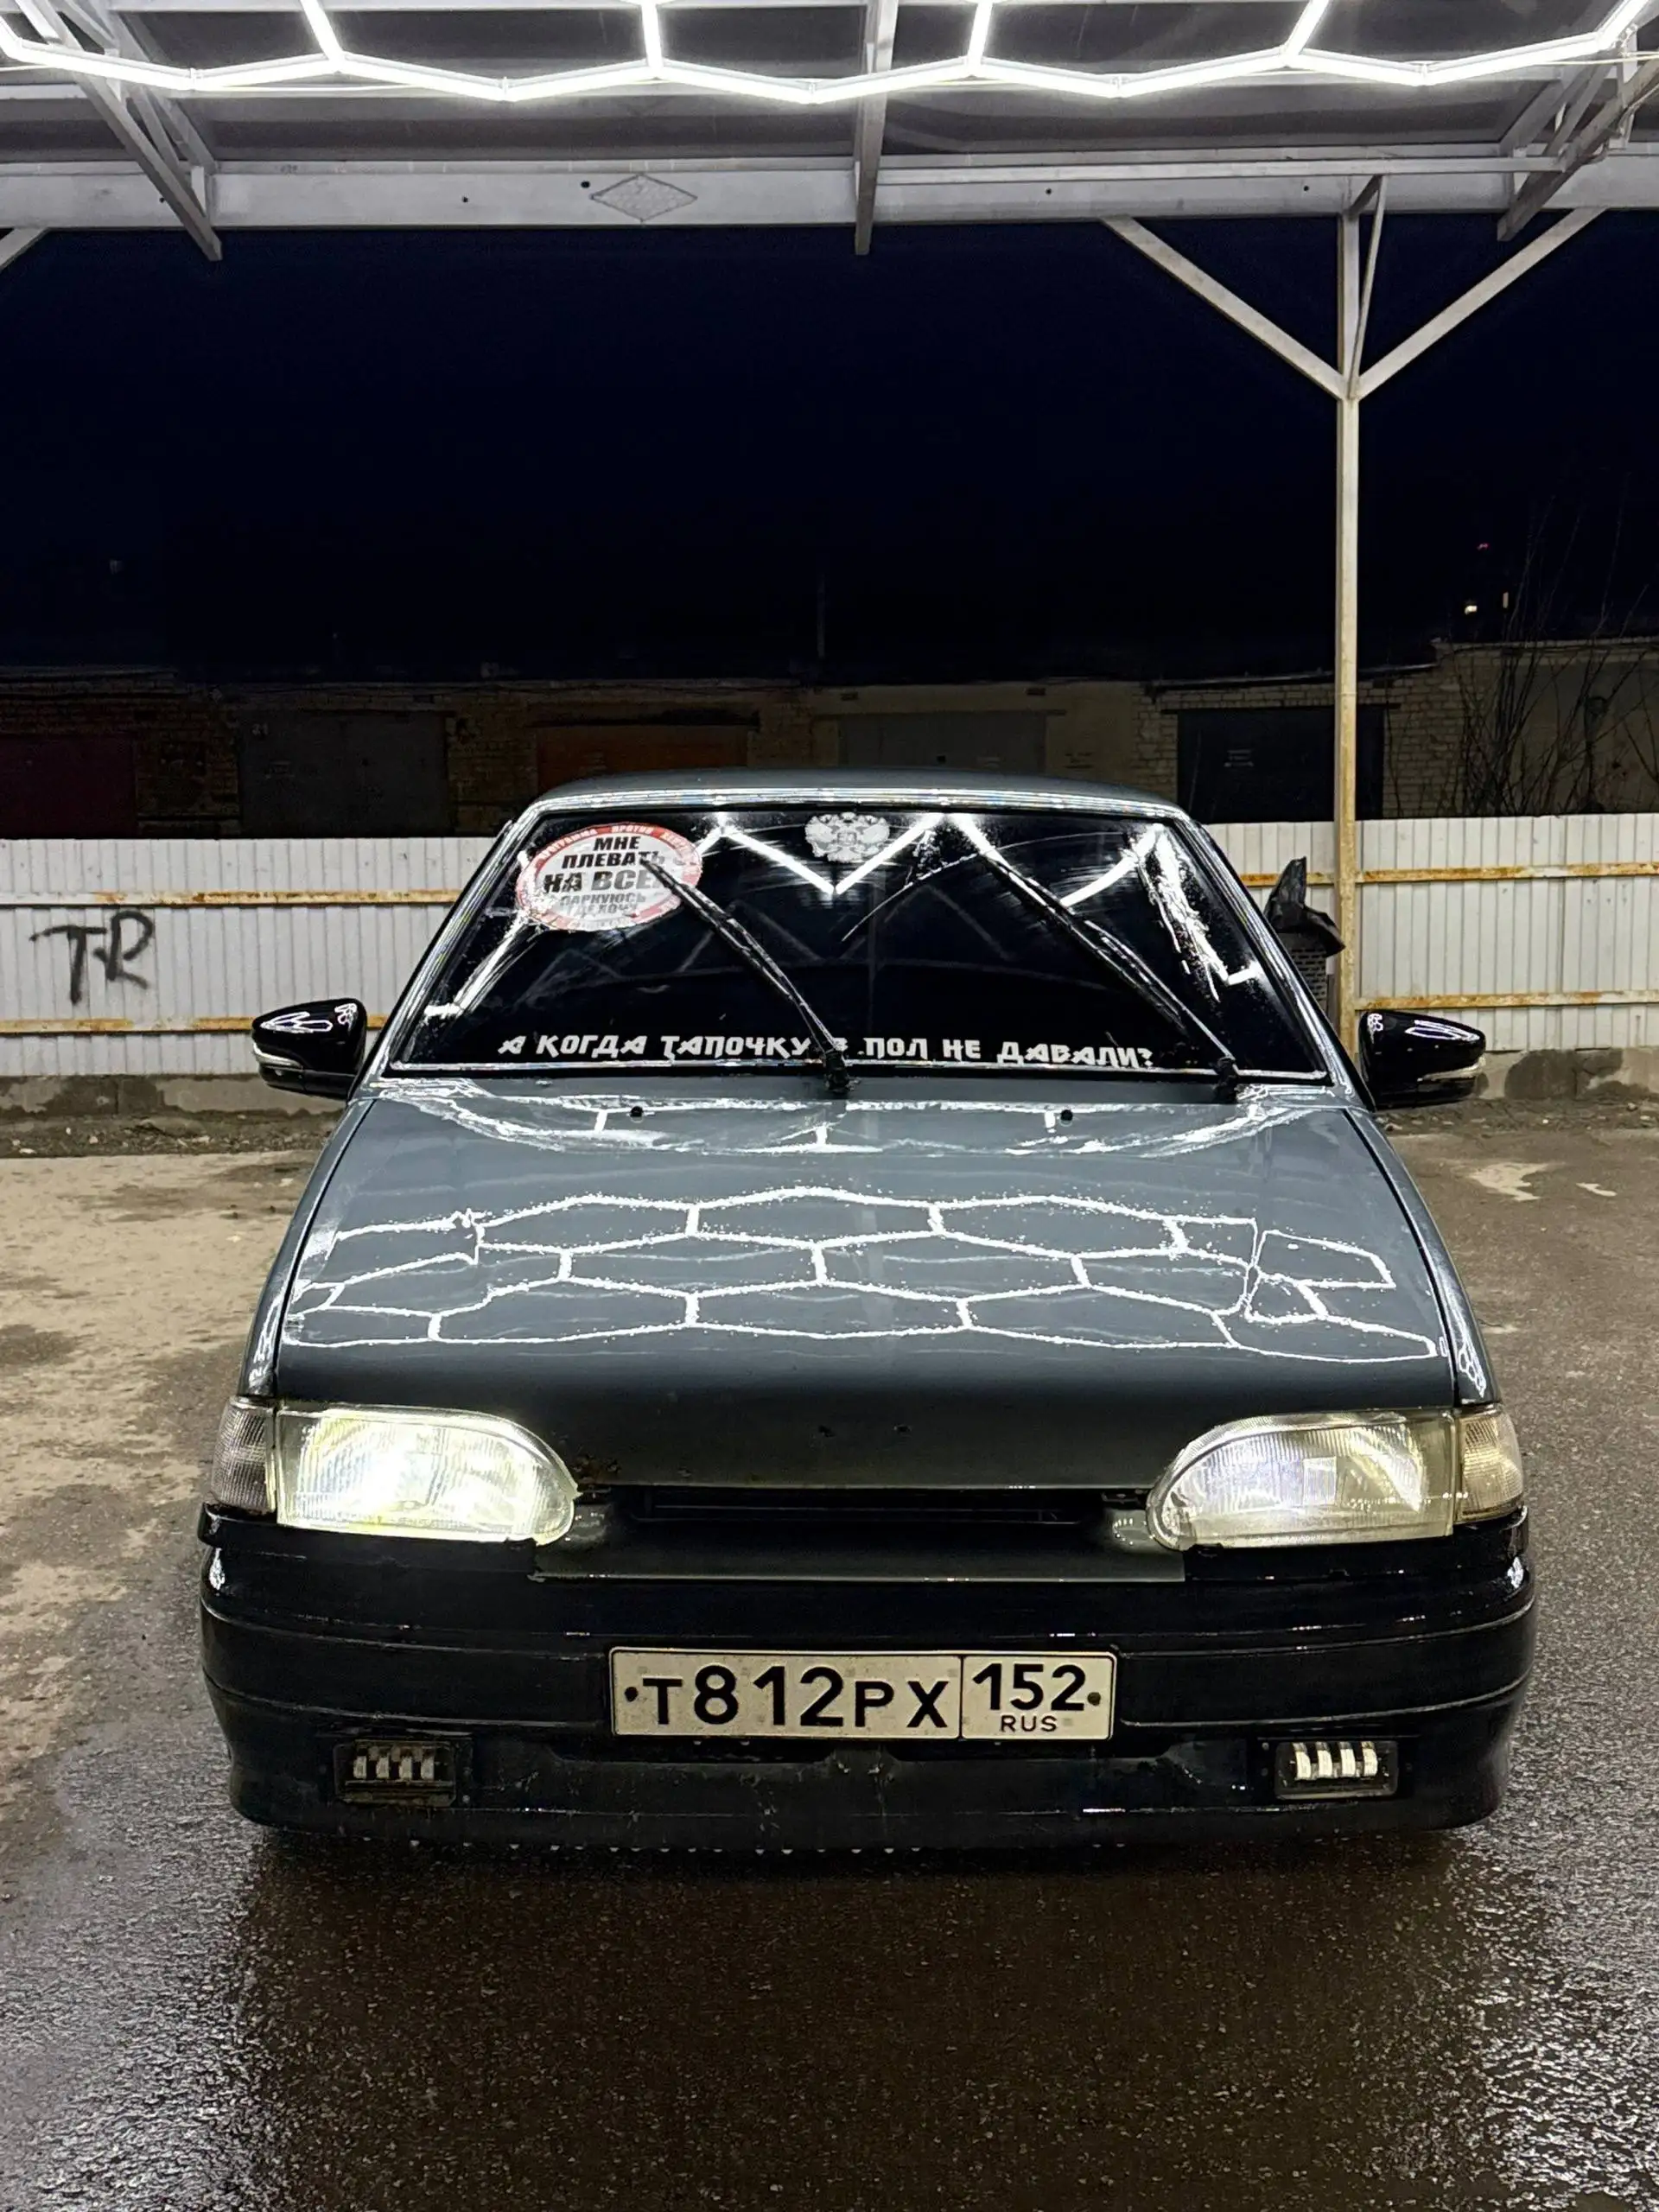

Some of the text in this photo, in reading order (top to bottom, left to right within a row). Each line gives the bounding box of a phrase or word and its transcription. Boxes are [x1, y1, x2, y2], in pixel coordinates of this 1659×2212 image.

[593, 836, 641, 851] МНЕ
[562, 851, 665, 869] ПЛЕВАТЬ
[543, 868, 663, 893] НА ВСЕ
[498, 1036, 526, 1054] А
[536, 1035, 647, 1058] КОГДА
[661, 1036, 811, 1059] ТАПОЧКУ
[863, 1037, 928, 1060] ПОЛ
[943, 1039, 982, 1062] НЕ
[997, 1041, 1154, 1069] ДАВАЛИ?
[972, 1662, 1086, 1711] 152
[1001, 1714, 1057, 1732] RUS
